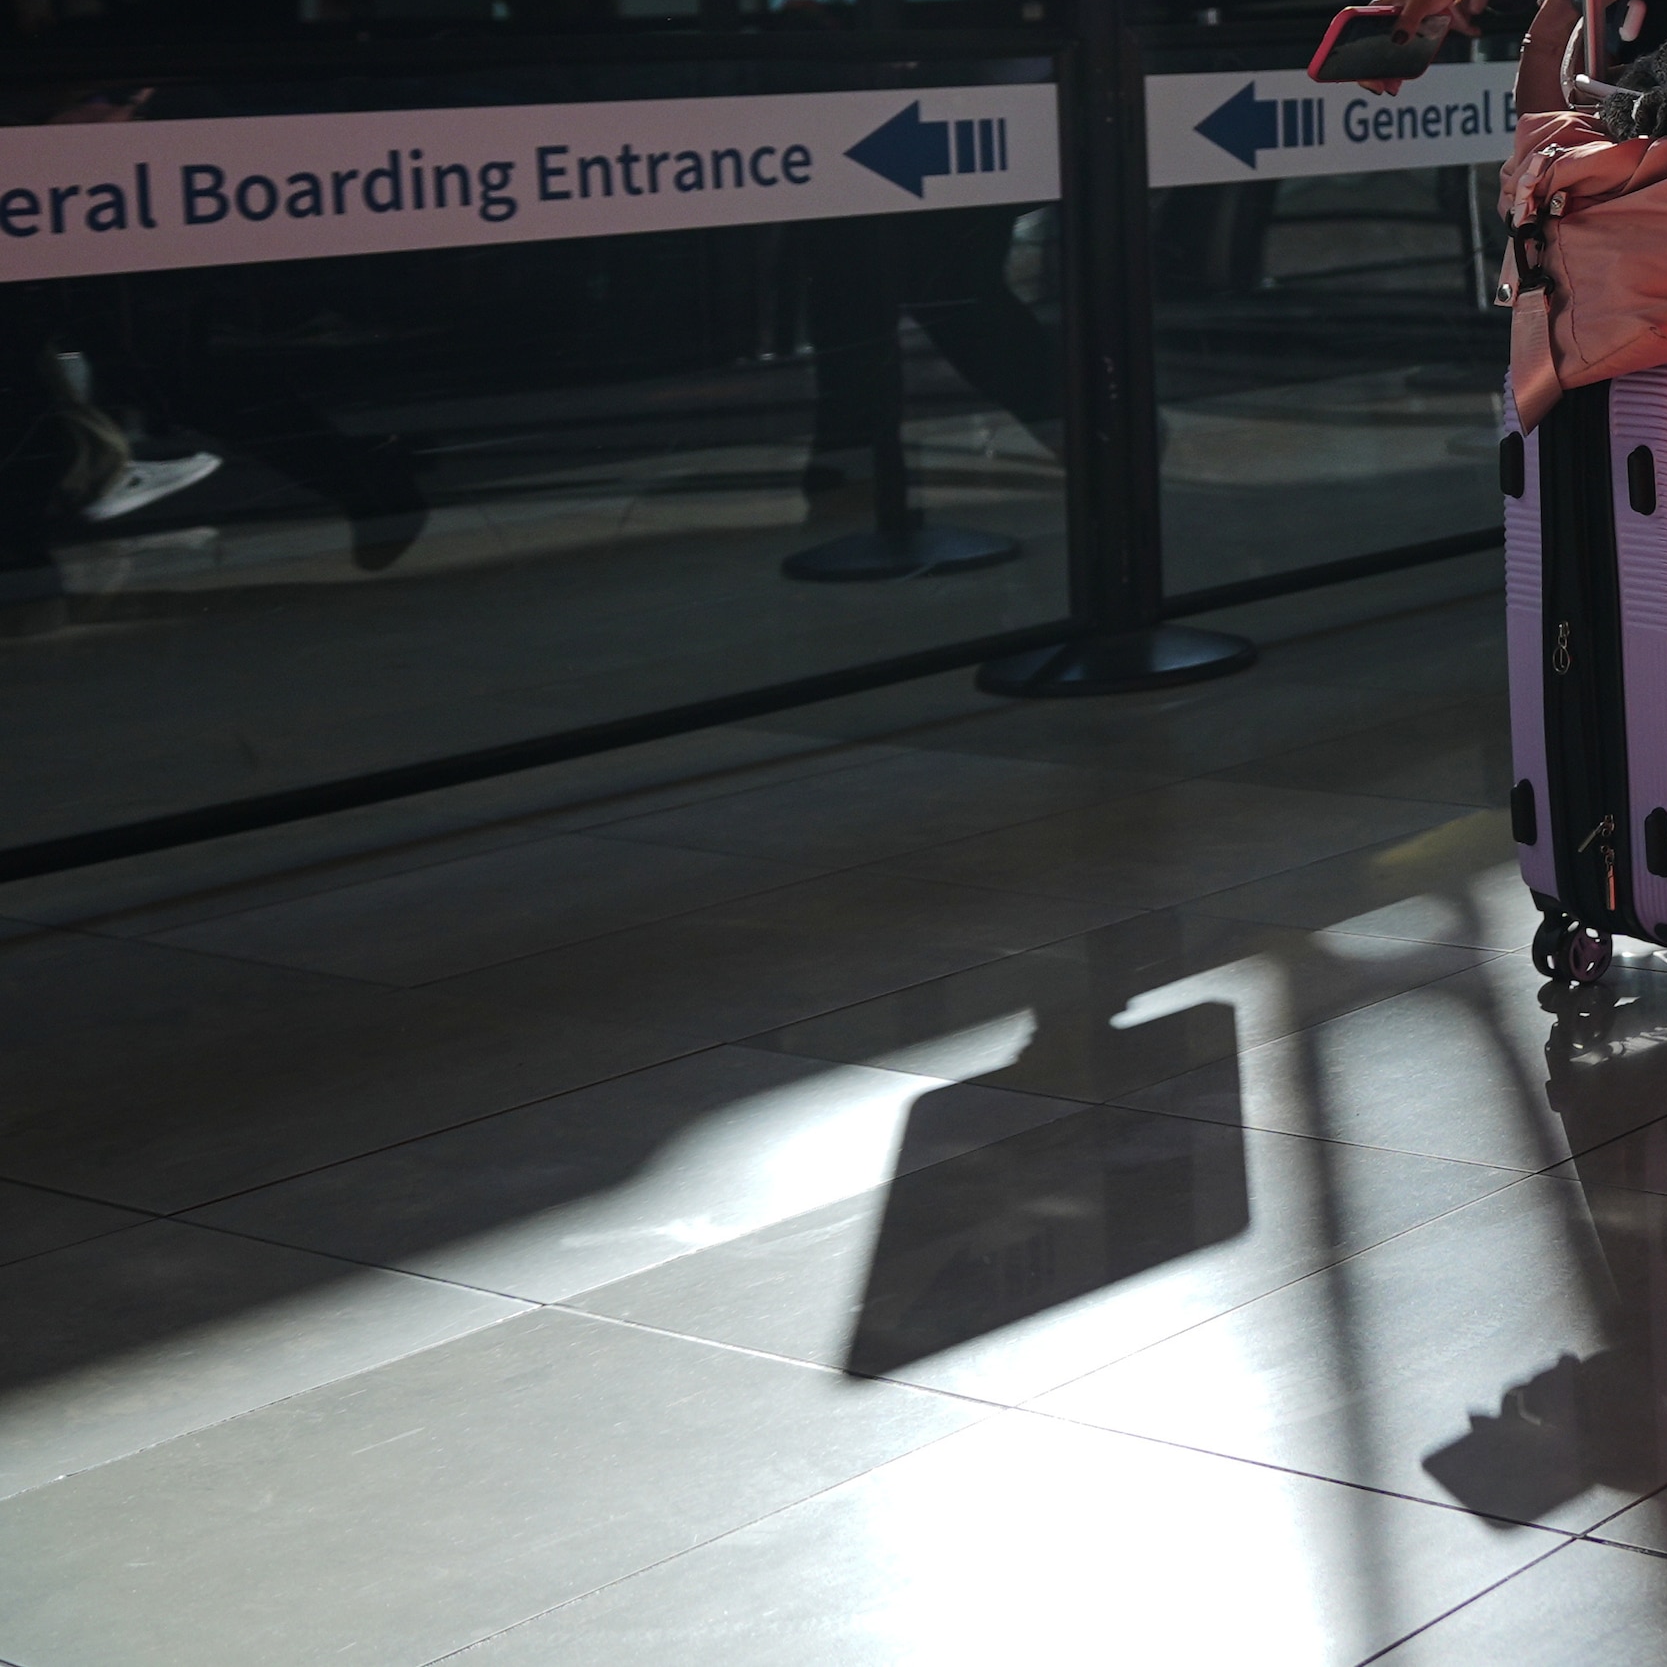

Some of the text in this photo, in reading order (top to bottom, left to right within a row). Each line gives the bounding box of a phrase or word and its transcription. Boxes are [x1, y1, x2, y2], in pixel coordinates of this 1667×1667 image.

[1344, 89, 1493, 143] General
[181, 149, 518, 223] Boarding
[536, 143, 813, 202] Entrance
